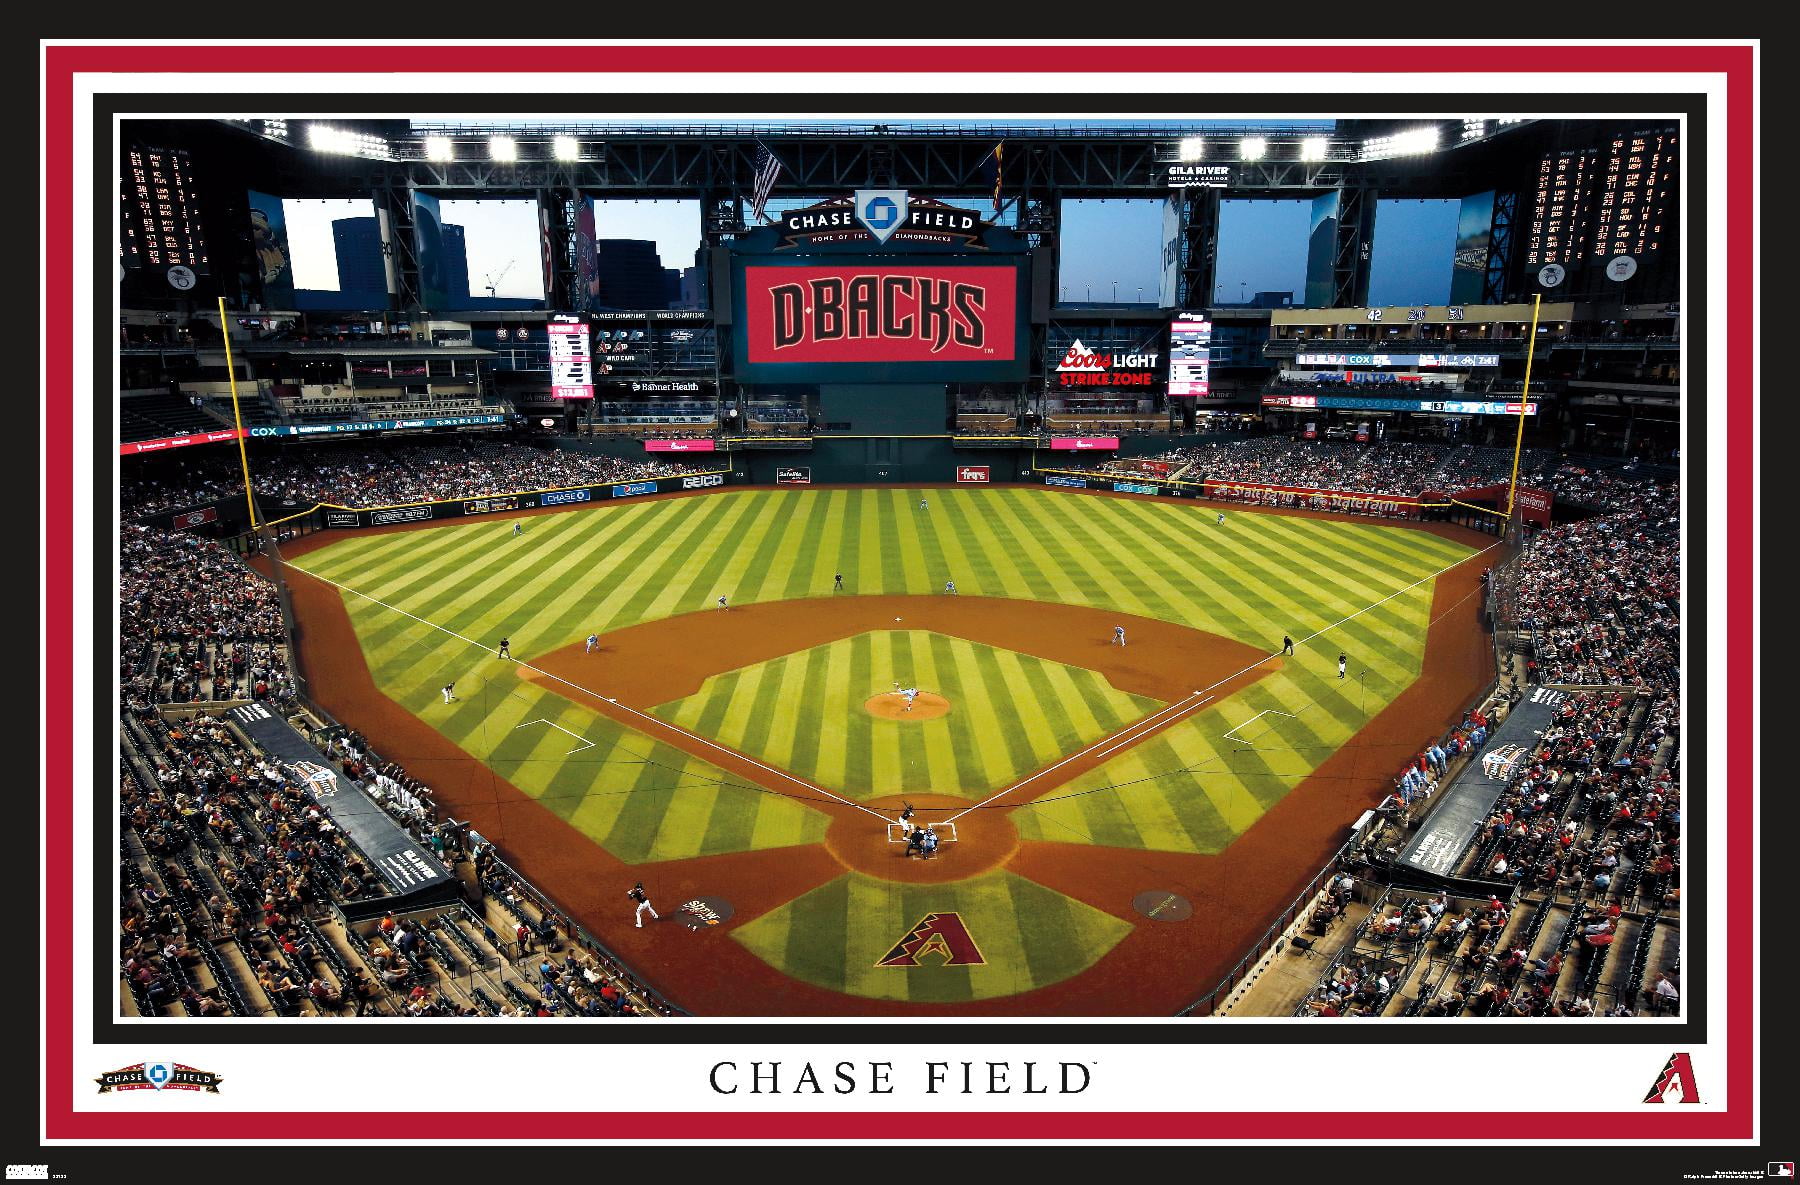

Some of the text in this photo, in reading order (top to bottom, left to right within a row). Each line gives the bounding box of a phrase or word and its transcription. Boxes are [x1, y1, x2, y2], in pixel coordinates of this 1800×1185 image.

[1168, 166, 1228, 175] GILA RIVER
[789, 212, 974, 230] CHASE FIELD
[812, 235, 834, 243] HOME
[895, 233, 951, 243] DIAMONDBACKS
[1366, 309, 1382, 321] 42
[1060, 348, 1159, 368] Coors LIGHT
[1060, 372, 1152, 386] STRIKE ZONE
[1354, 373, 1396, 382] ULTRA
[642, 382, 699, 391] Banner Health
[252, 428, 276, 436] COX
[682, 474, 724, 488] GEICO
[1119, 484, 1133, 492] COX
[547, 493, 576, 502] CHASE
